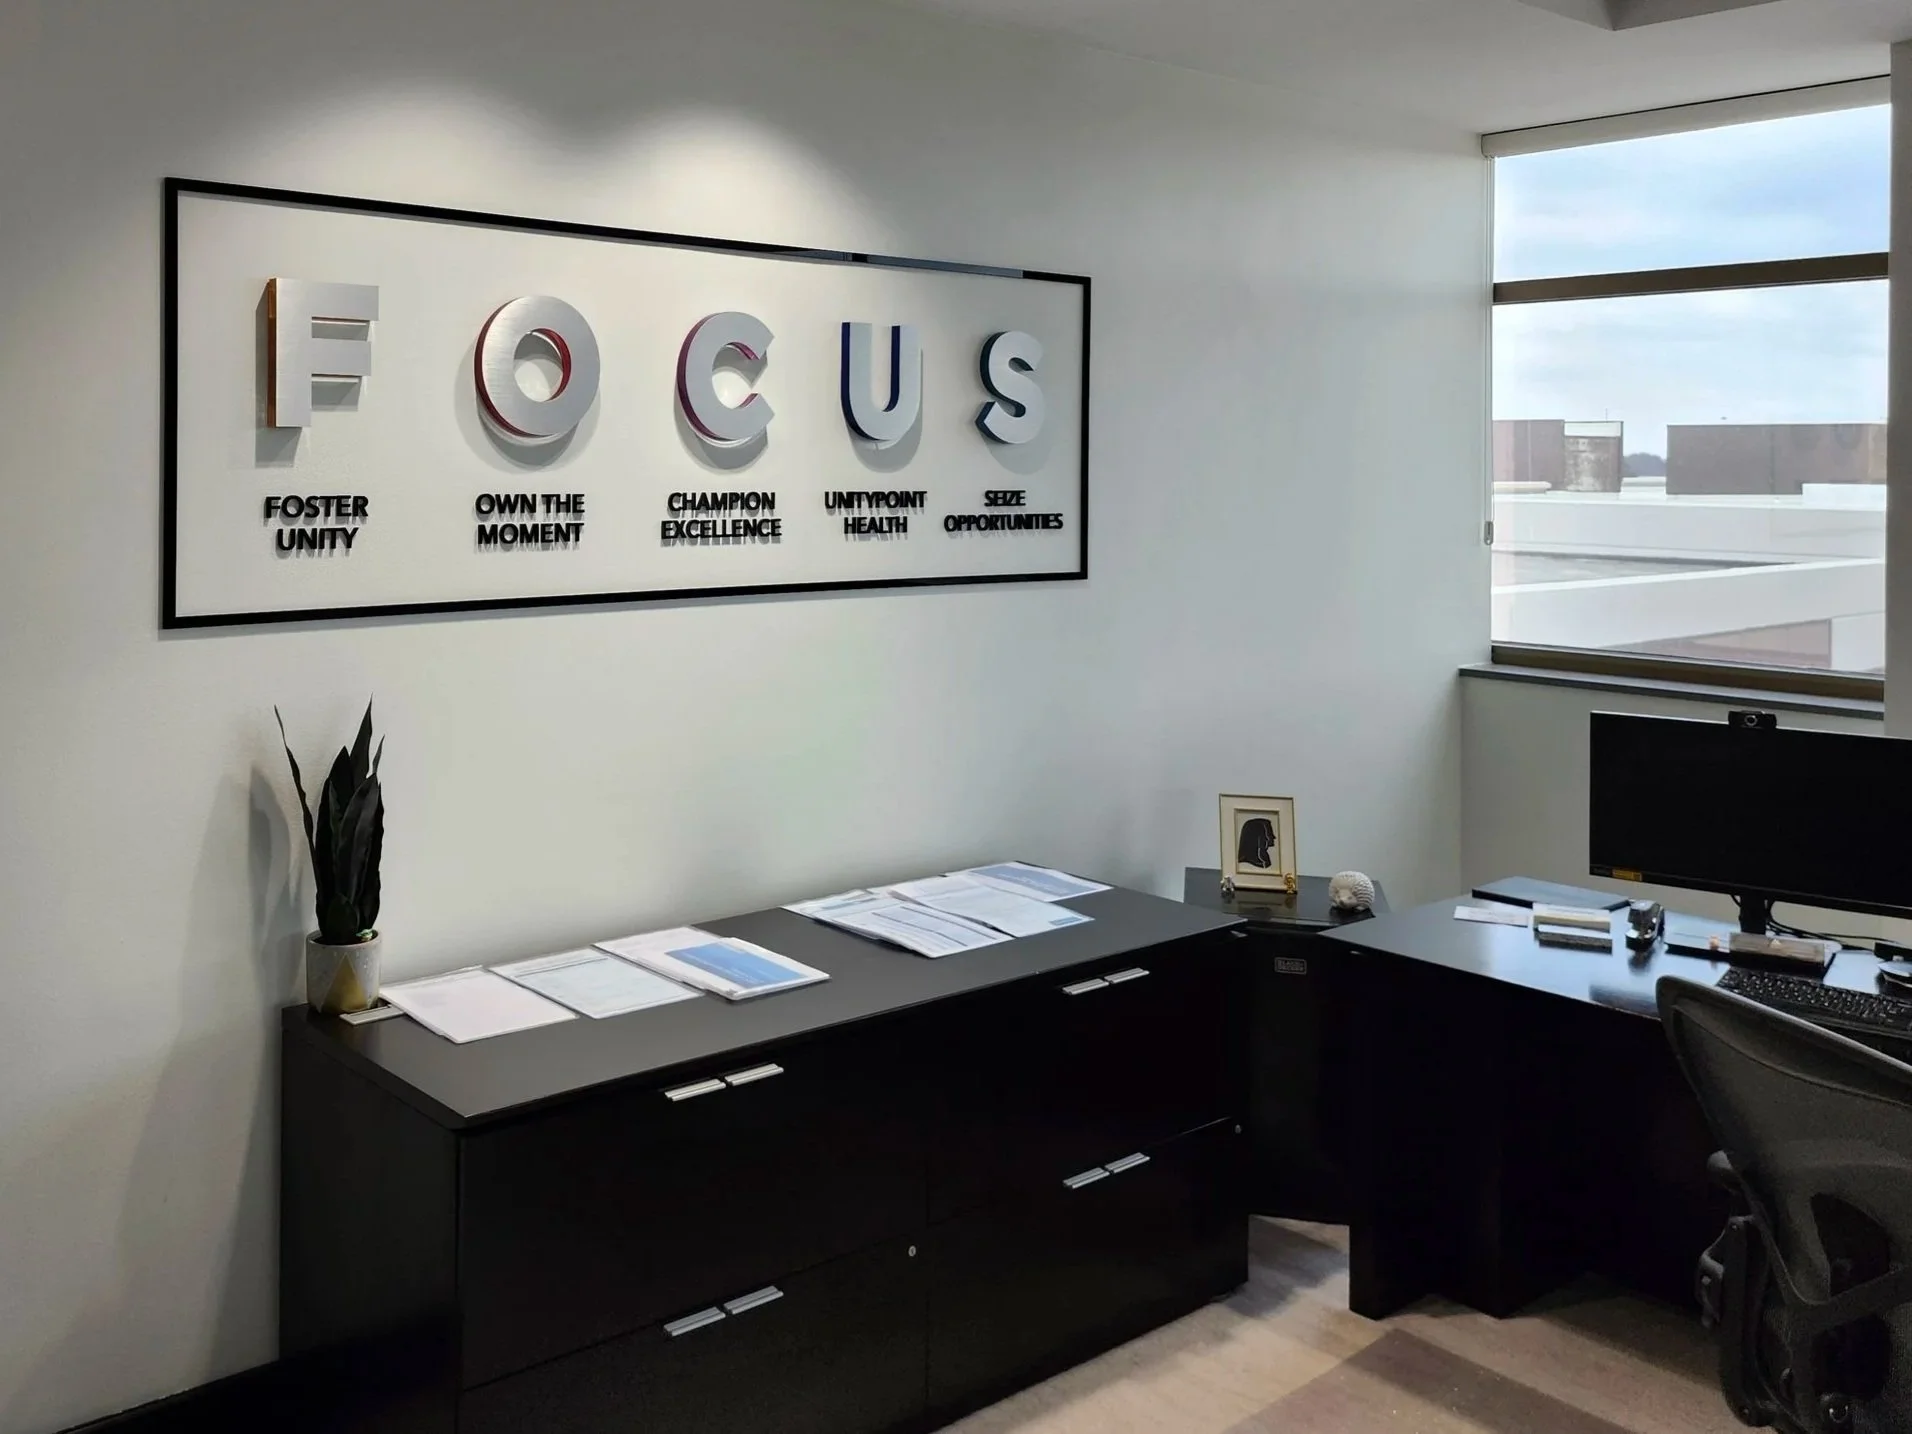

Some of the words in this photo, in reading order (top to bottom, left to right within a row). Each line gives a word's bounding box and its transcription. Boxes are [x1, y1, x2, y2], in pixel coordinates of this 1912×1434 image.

[266, 277, 1045, 443] FOCUS
[264, 496, 368, 518] FOSTER
[475, 494, 537, 514] OWN
[542, 494, 585, 514] THE
[667, 492, 775, 511] CHAMPION
[824, 491, 927, 509] UNITYPOINT
[984, 491, 1026, 507] SEIZE
[661, 519, 782, 539] EXCELLENCE
[844, 517, 908, 534] HEALTH
[944, 513, 1064, 532] OPPORTUNITIES
[277, 528, 358, 550] UNITY
[477, 523, 584, 544] MOMENT
